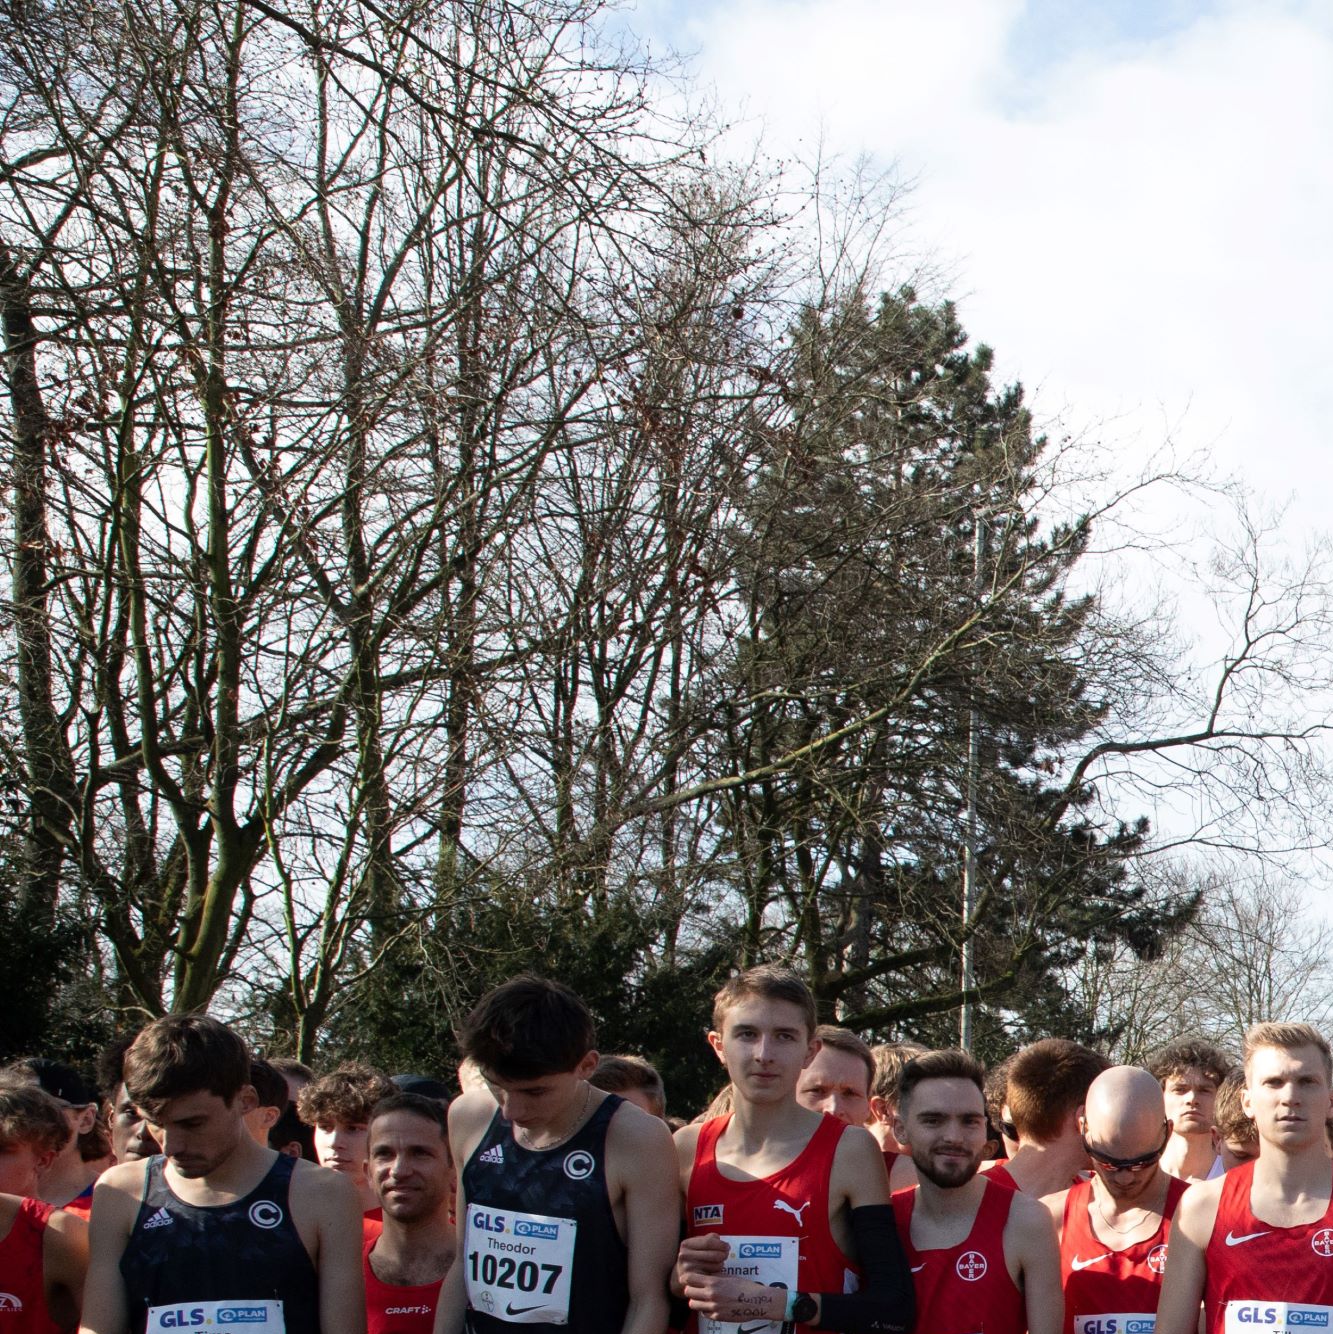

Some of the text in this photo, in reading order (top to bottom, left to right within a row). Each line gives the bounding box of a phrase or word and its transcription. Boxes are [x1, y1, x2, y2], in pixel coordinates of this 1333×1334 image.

[479, 1154, 504, 1164] adidas
[694, 1206, 721, 1220] NTA
[143, 1216, 174, 1230] adidas
[532, 1225, 557, 1235] PLAN
[487, 1237, 536, 1256] Theodor
[755, 1245, 780, 1253] PLAN
[469, 1250, 563, 1295] 10207
[720, 1265, 759, 1276] ennart
[237, 1309, 265, 1318] PLAN
[385, 1306, 421, 1315] CRAFT
[1303, 1313, 1328, 1322] PLAN
